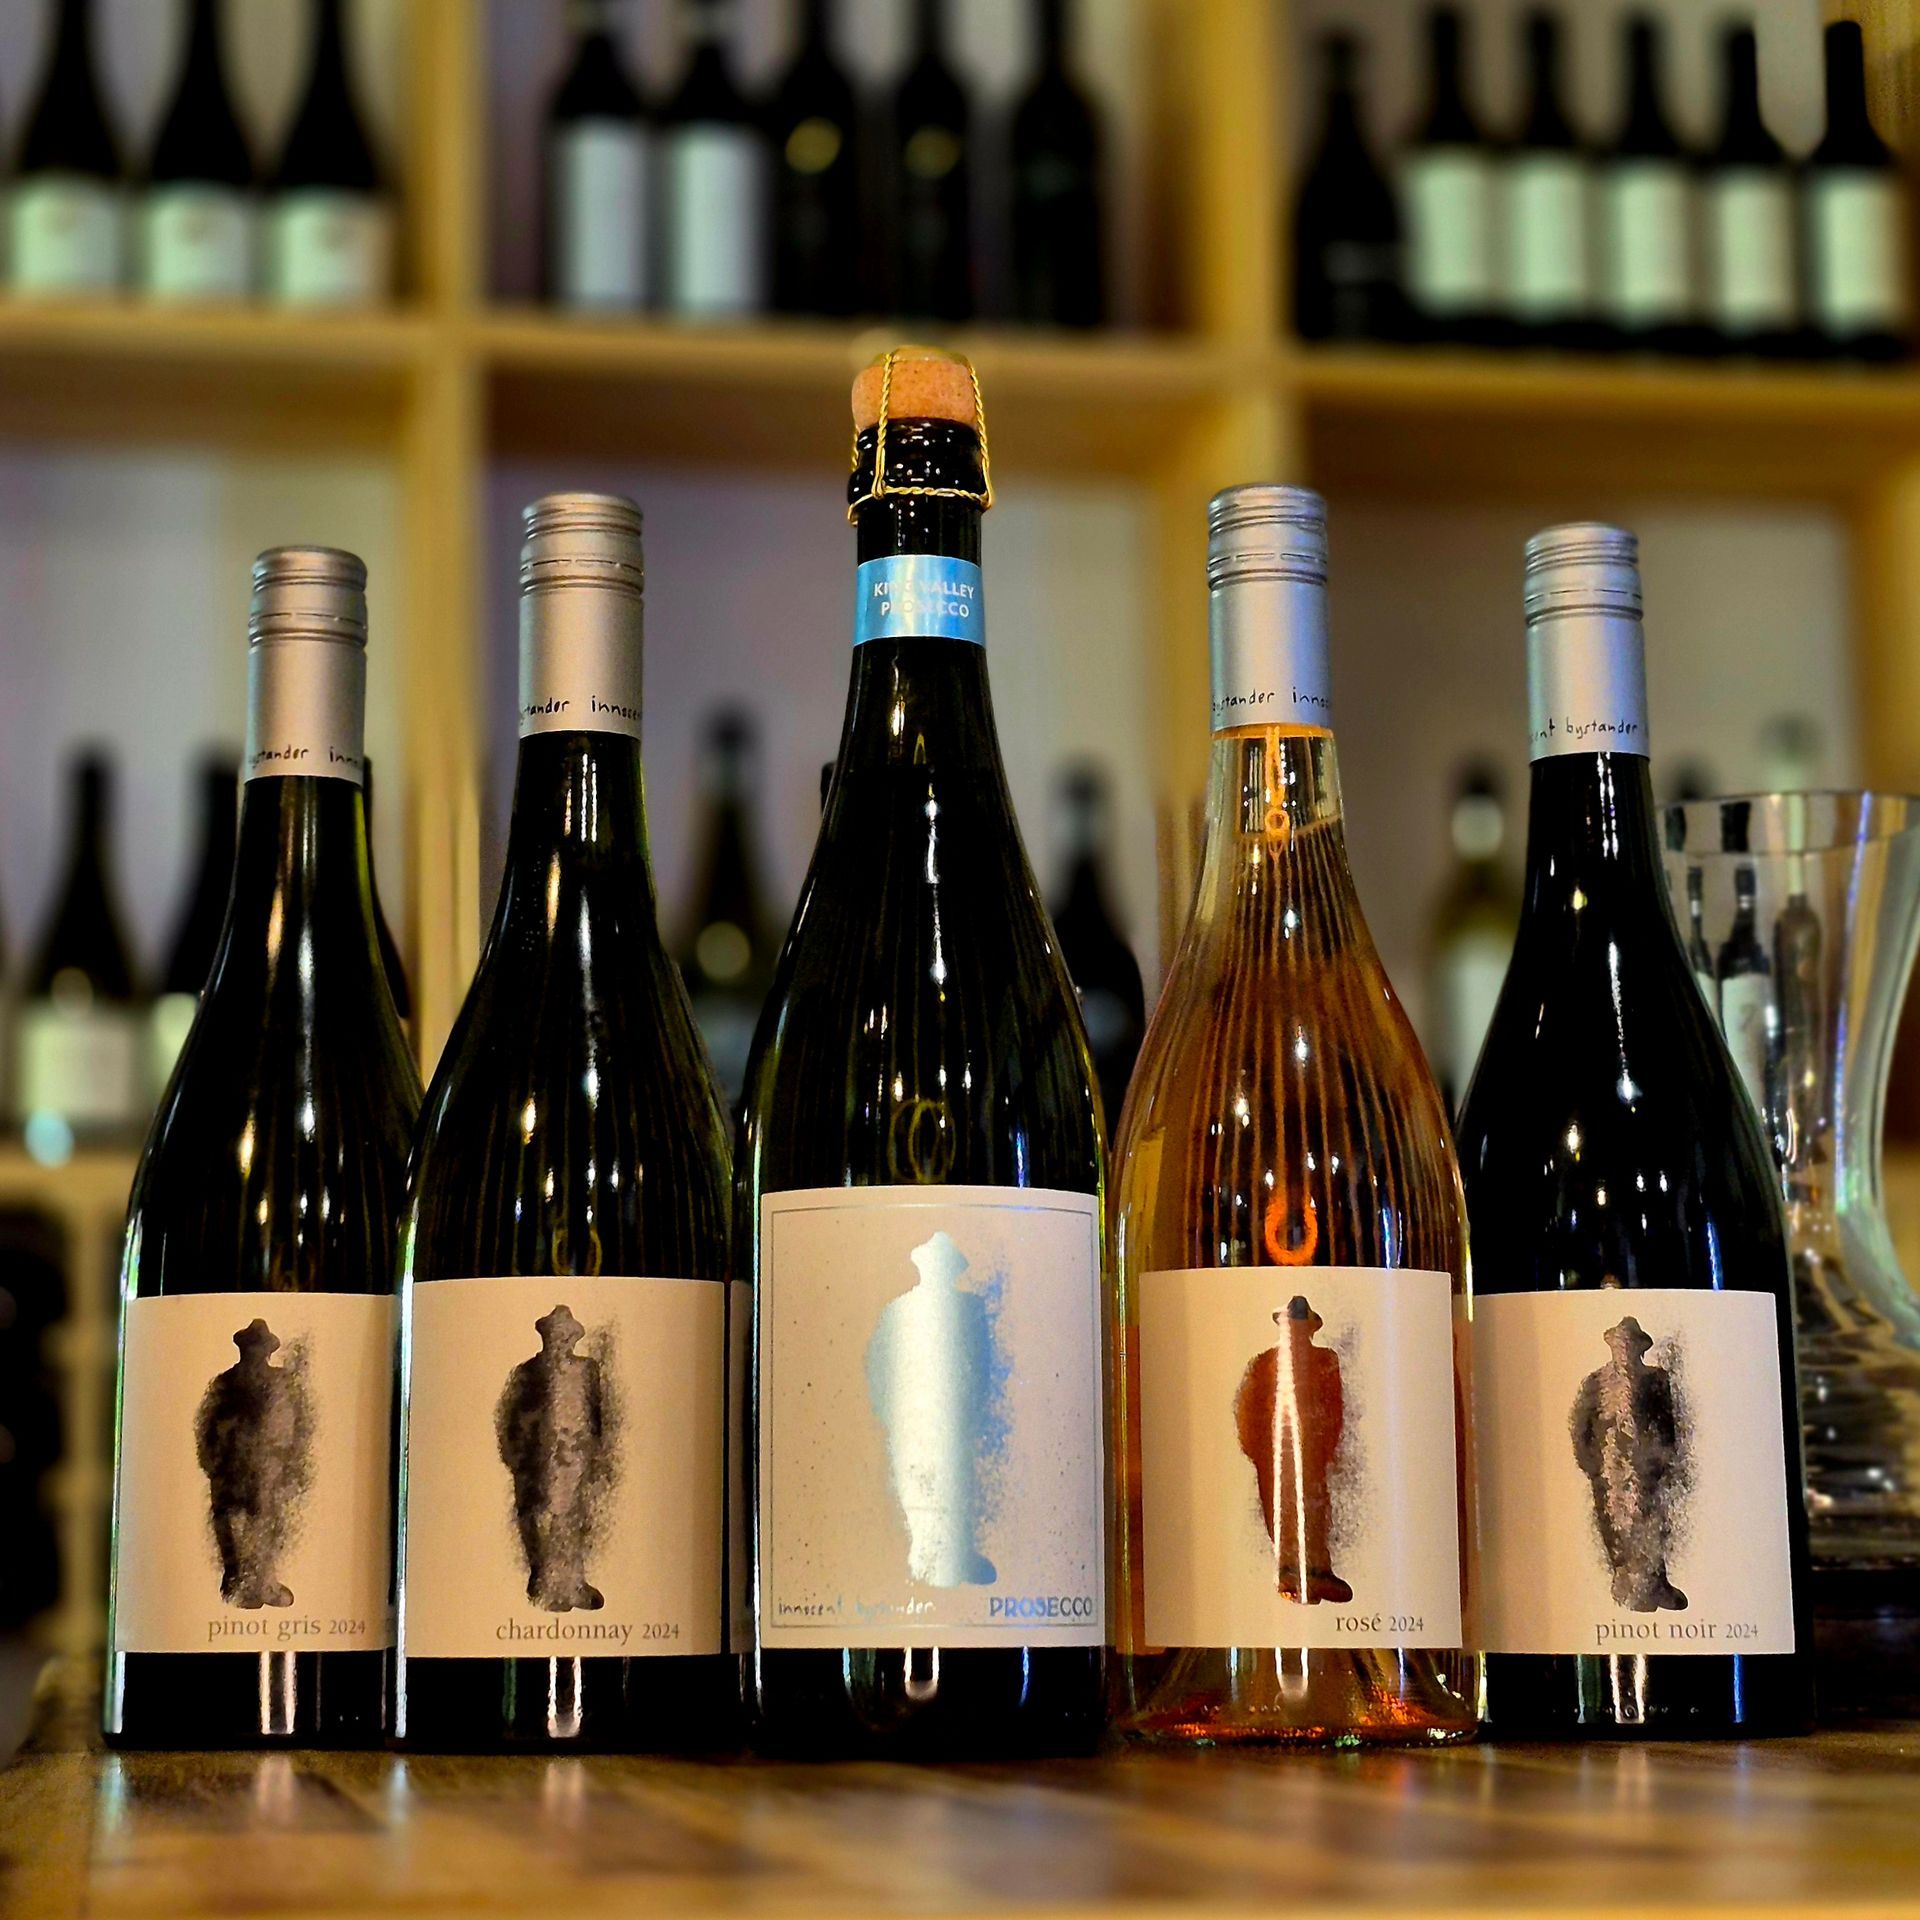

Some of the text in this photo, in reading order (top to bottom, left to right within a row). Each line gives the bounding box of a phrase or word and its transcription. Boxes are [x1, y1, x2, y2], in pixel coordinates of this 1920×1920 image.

[920, 581, 975, 599] VALLEY
[1566, 717, 1638, 740] bystander
[989, 1596, 1093, 1617] PROSECCO
[207, 1615, 366, 1643] pinot gris 2024
[496, 1617, 680, 1646] chardonnay 2024
[1336, 1613, 1424, 1632] rosé 2024
[1596, 1618, 1759, 1646] pinot noir 2024
